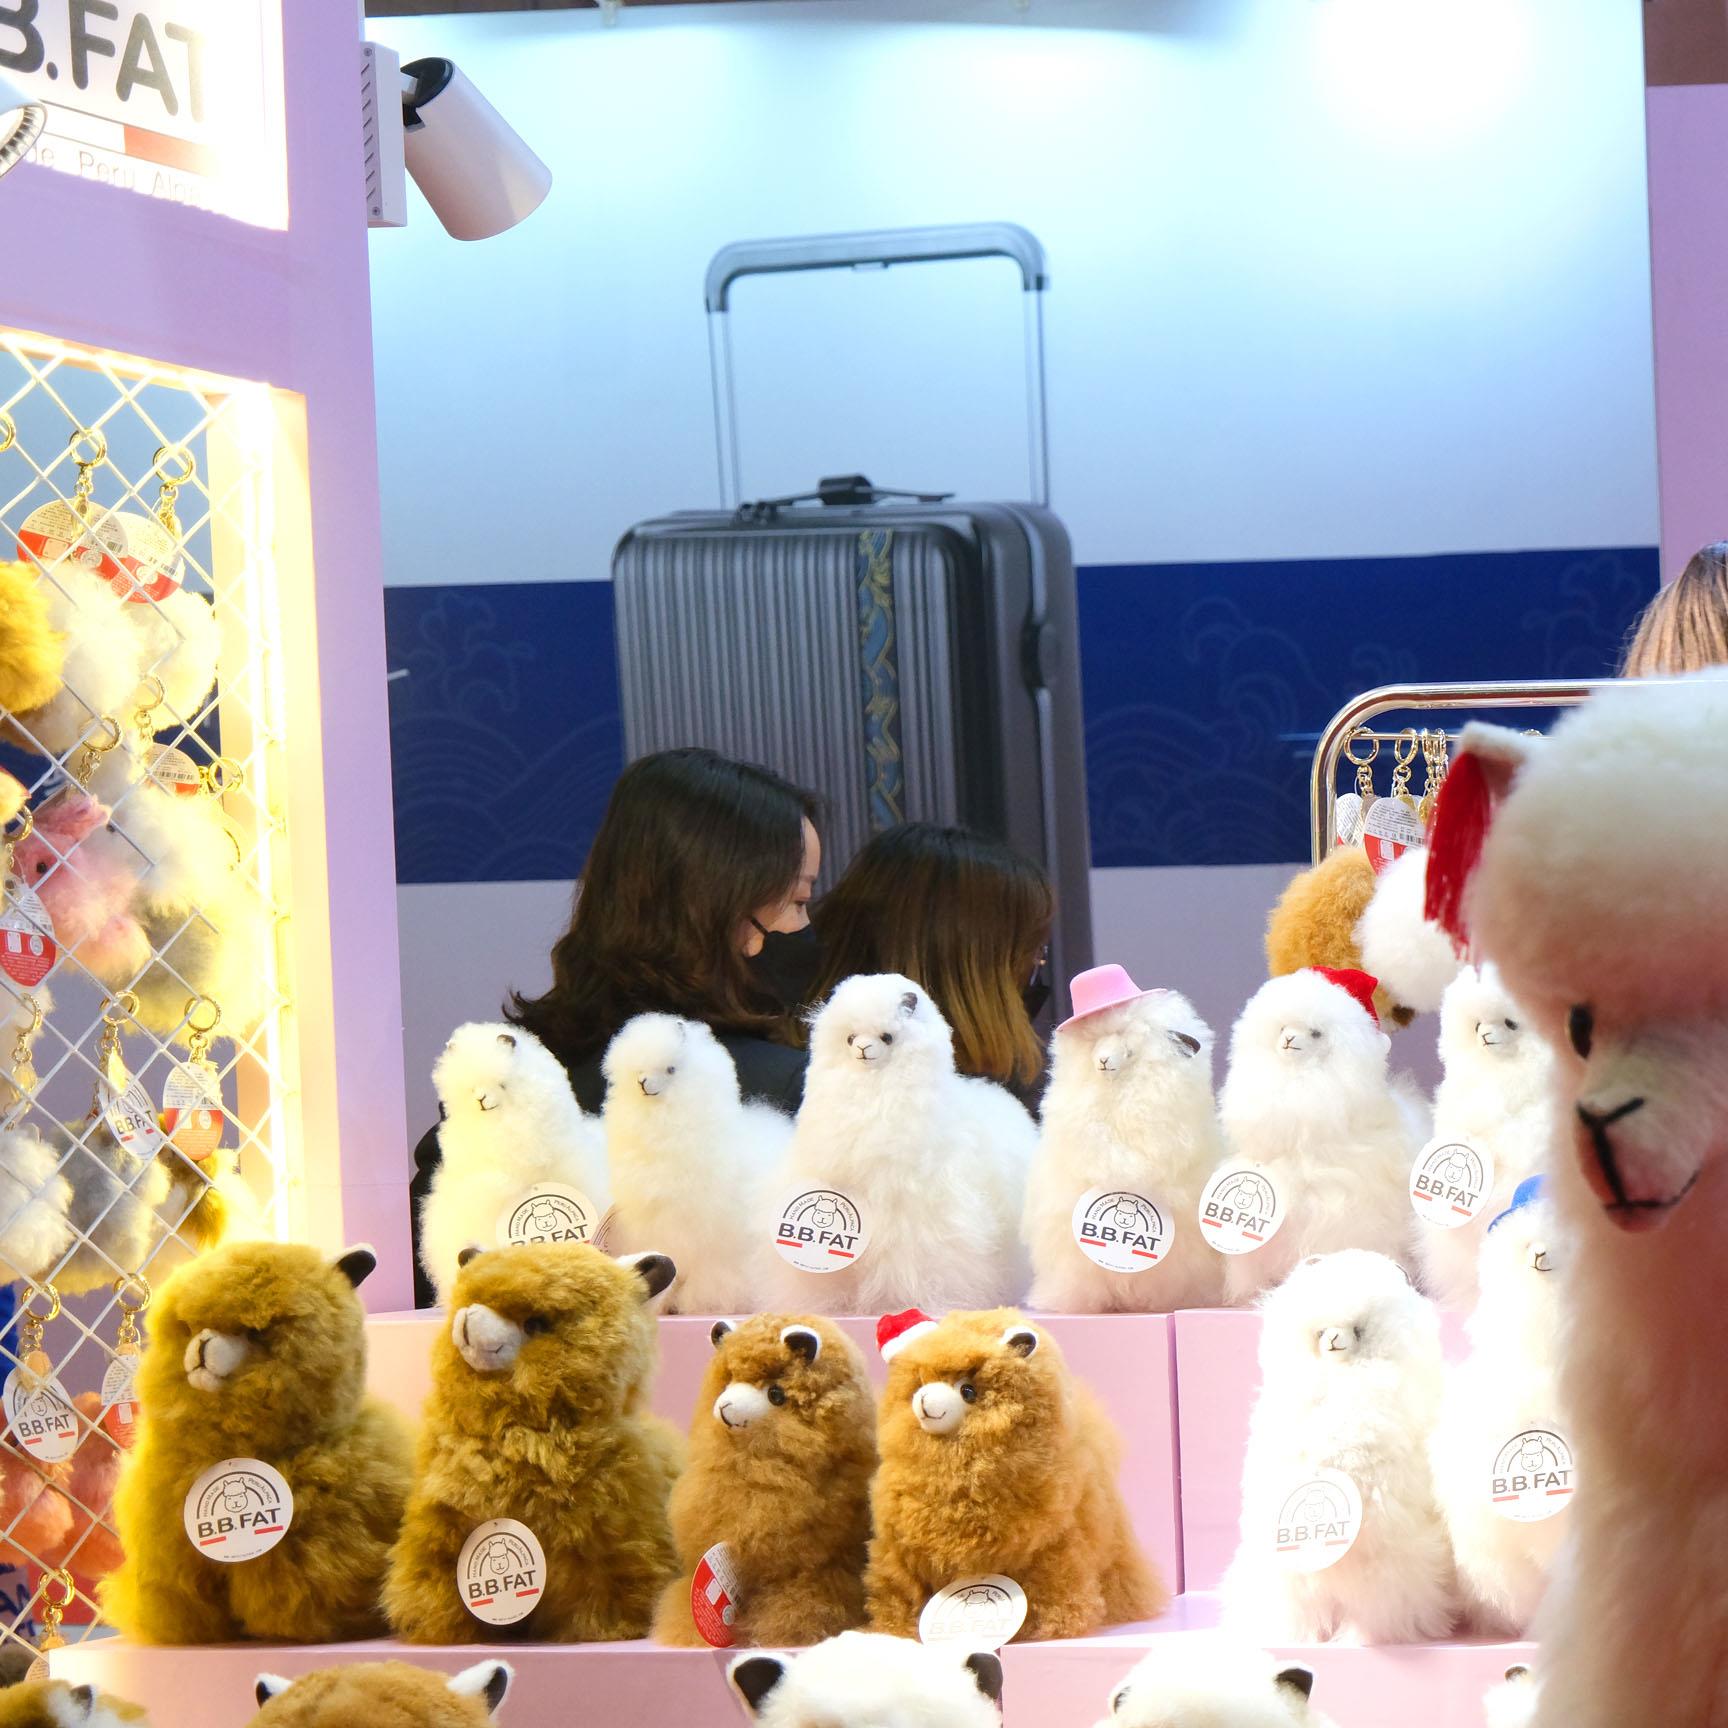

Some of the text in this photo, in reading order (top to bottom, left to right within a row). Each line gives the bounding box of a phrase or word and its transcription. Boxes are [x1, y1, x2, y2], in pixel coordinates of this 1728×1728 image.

[1415, 1174, 1478, 1207] B.B.FAT
[1205, 1202, 1270, 1233] B.B.FAT
[778, 1222, 859, 1250] B.B.FAT
[1081, 1222, 1161, 1250] B.B.FAT
[18, 1413, 71, 1438] B.B.FAT
[1492, 1469, 1573, 1494] B.B.FAT
[198, 1507, 281, 1538] B.B.FAT
[468, 1569, 536, 1599] B.B.FAT
